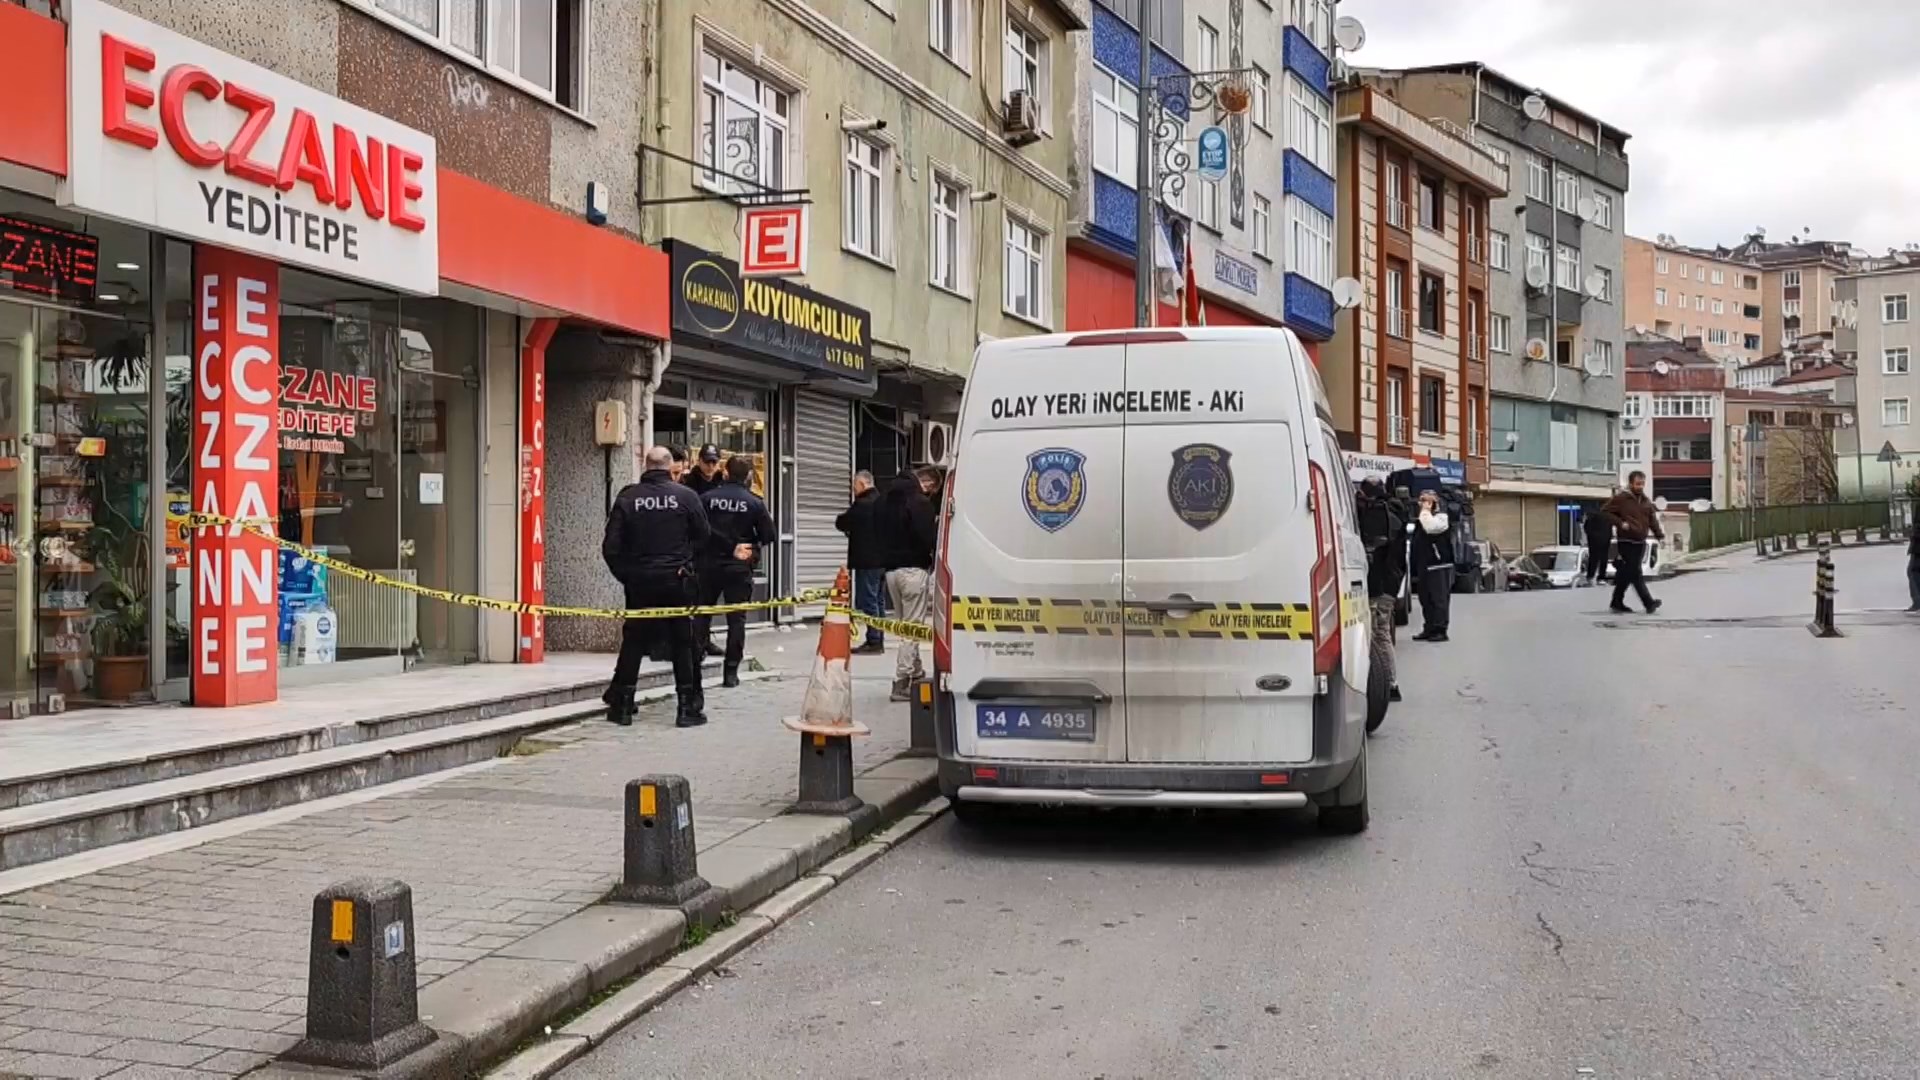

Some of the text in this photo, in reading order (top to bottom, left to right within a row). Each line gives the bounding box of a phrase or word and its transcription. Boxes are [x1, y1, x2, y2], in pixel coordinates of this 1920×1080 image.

[101, 31, 425, 232] ECZANE
[198, 181, 359, 261] YEDİTEPE
[757, 216, 788, 264] E
[685, 281, 736, 315] KARAKAYALI
[743, 278, 863, 347] KUYUMCULUK
[855, 354, 864, 370] 01
[991, 395, 1038, 420] OLAY
[1044, 392, 1087, 417] YERİ
[1092, 389, 1192, 414] İNCELEME
[1209, 389, 1244, 413] AKİ
[198, 274, 223, 675] ECZANE
[229, 276, 275, 674] ECZANE
[533, 372, 543, 639] ECZANE
[634, 495, 679, 511] POLİS
[710, 497, 748, 512] POLİS
[967, 606, 985, 620] OLAY
[1083, 610, 1104, 624] OLAY
[1209, 613, 1230, 628] OLAY
[984, 711, 1086, 728] 34 A 4935
